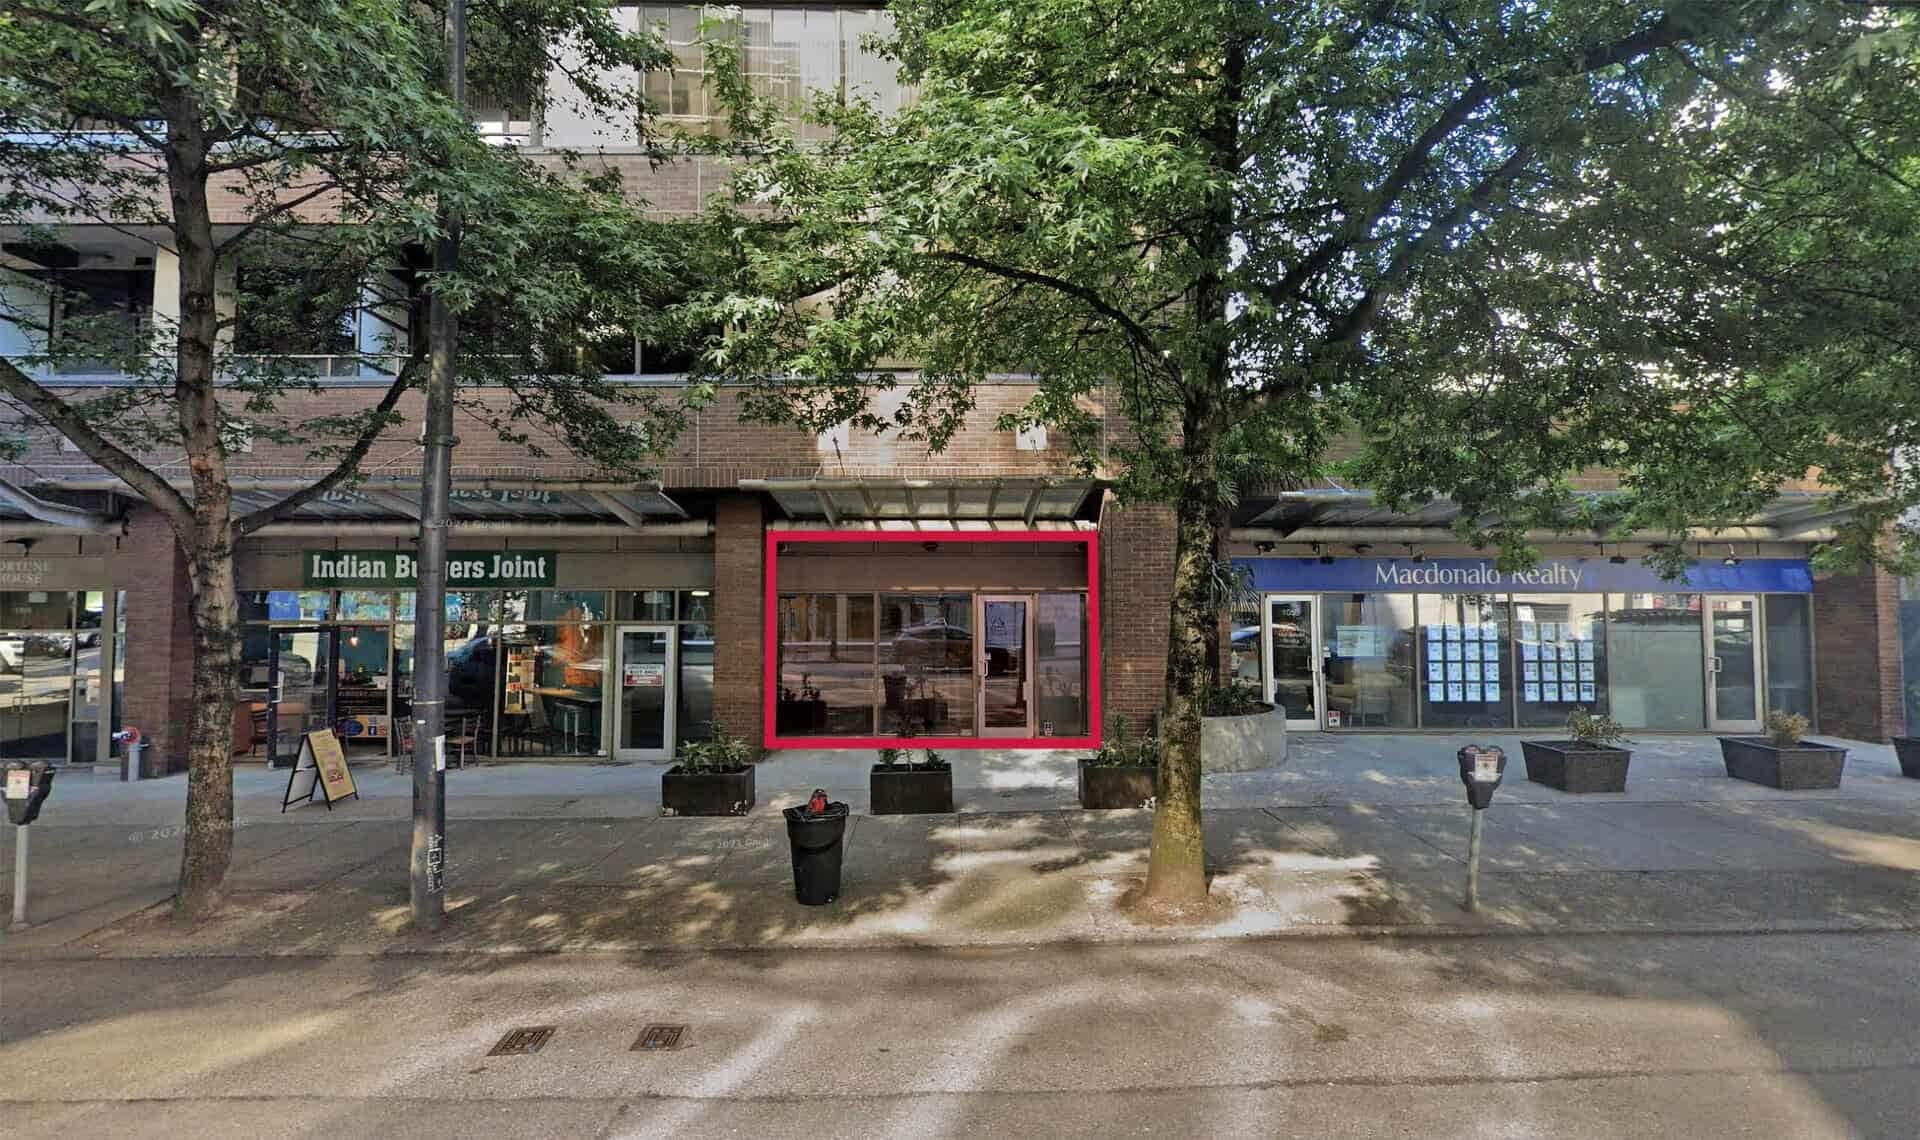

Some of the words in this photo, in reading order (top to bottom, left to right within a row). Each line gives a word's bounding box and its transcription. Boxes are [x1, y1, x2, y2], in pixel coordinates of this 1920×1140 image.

[312, 554, 386, 578] Indian
[395, 554, 485, 581] Bers
[489, 555, 546, 578] Joint
[1376, 562, 1500, 585] Macdonald
